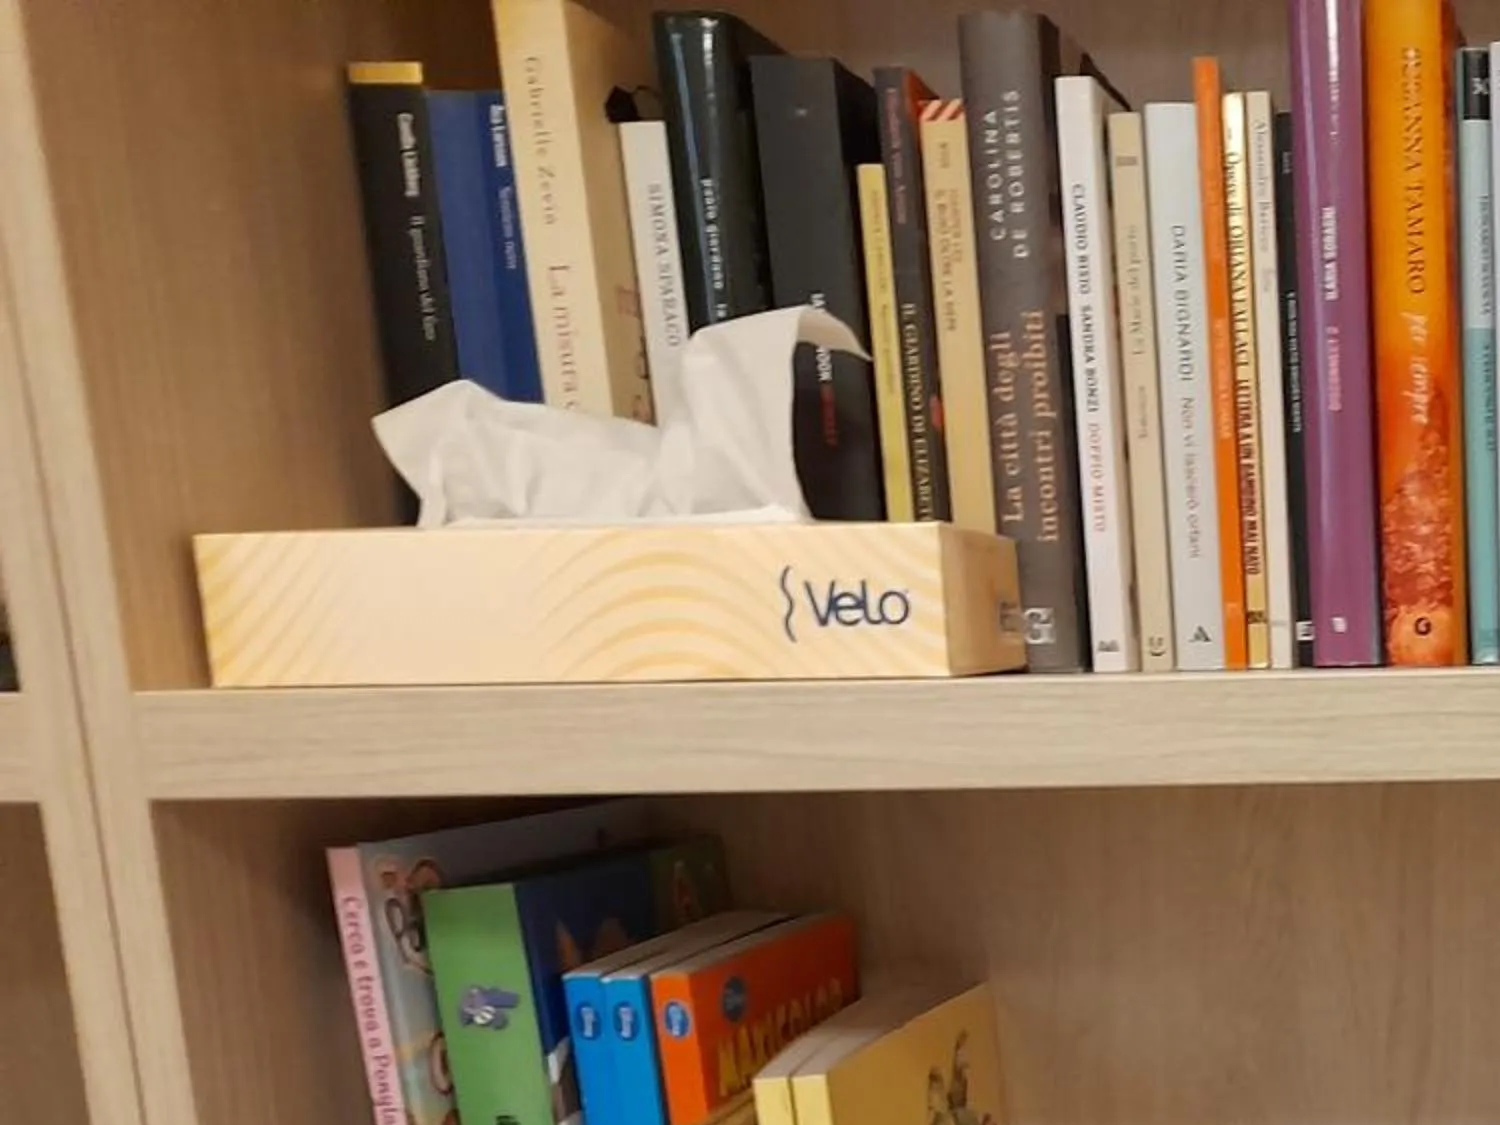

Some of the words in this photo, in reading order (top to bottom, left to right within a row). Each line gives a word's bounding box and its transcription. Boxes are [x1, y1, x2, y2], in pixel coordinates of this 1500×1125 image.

[523, 56, 552, 156] Gabrielle
[1001, 88, 1026, 213] ROBERTIS
[1400, 48, 1421, 176] SUSANNA
[537, 166, 560, 226] Zevin
[982, 109, 1007, 241] CAROLINA
[548, 265, 572, 297] La
[1011, 228, 1030, 258] DE
[1071, 184, 1088, 249] CLAUDIO
[1080, 305, 1097, 363] SANDRA
[1170, 225, 1186, 282] DARIA
[1405, 182, 1426, 294] TAMARO
[552, 305, 582, 387] misura
[989, 332, 1020, 401] degli
[1020, 310, 1055, 417] proibiti
[1174, 289, 1194, 382] BIGNARDI
[1002, 486, 1025, 522] La
[1034, 429, 1061, 543] incontri
[803, 579, 910, 627] Velo
[341, 890, 365, 956] Cerca
[357, 974, 383, 1032] trova
